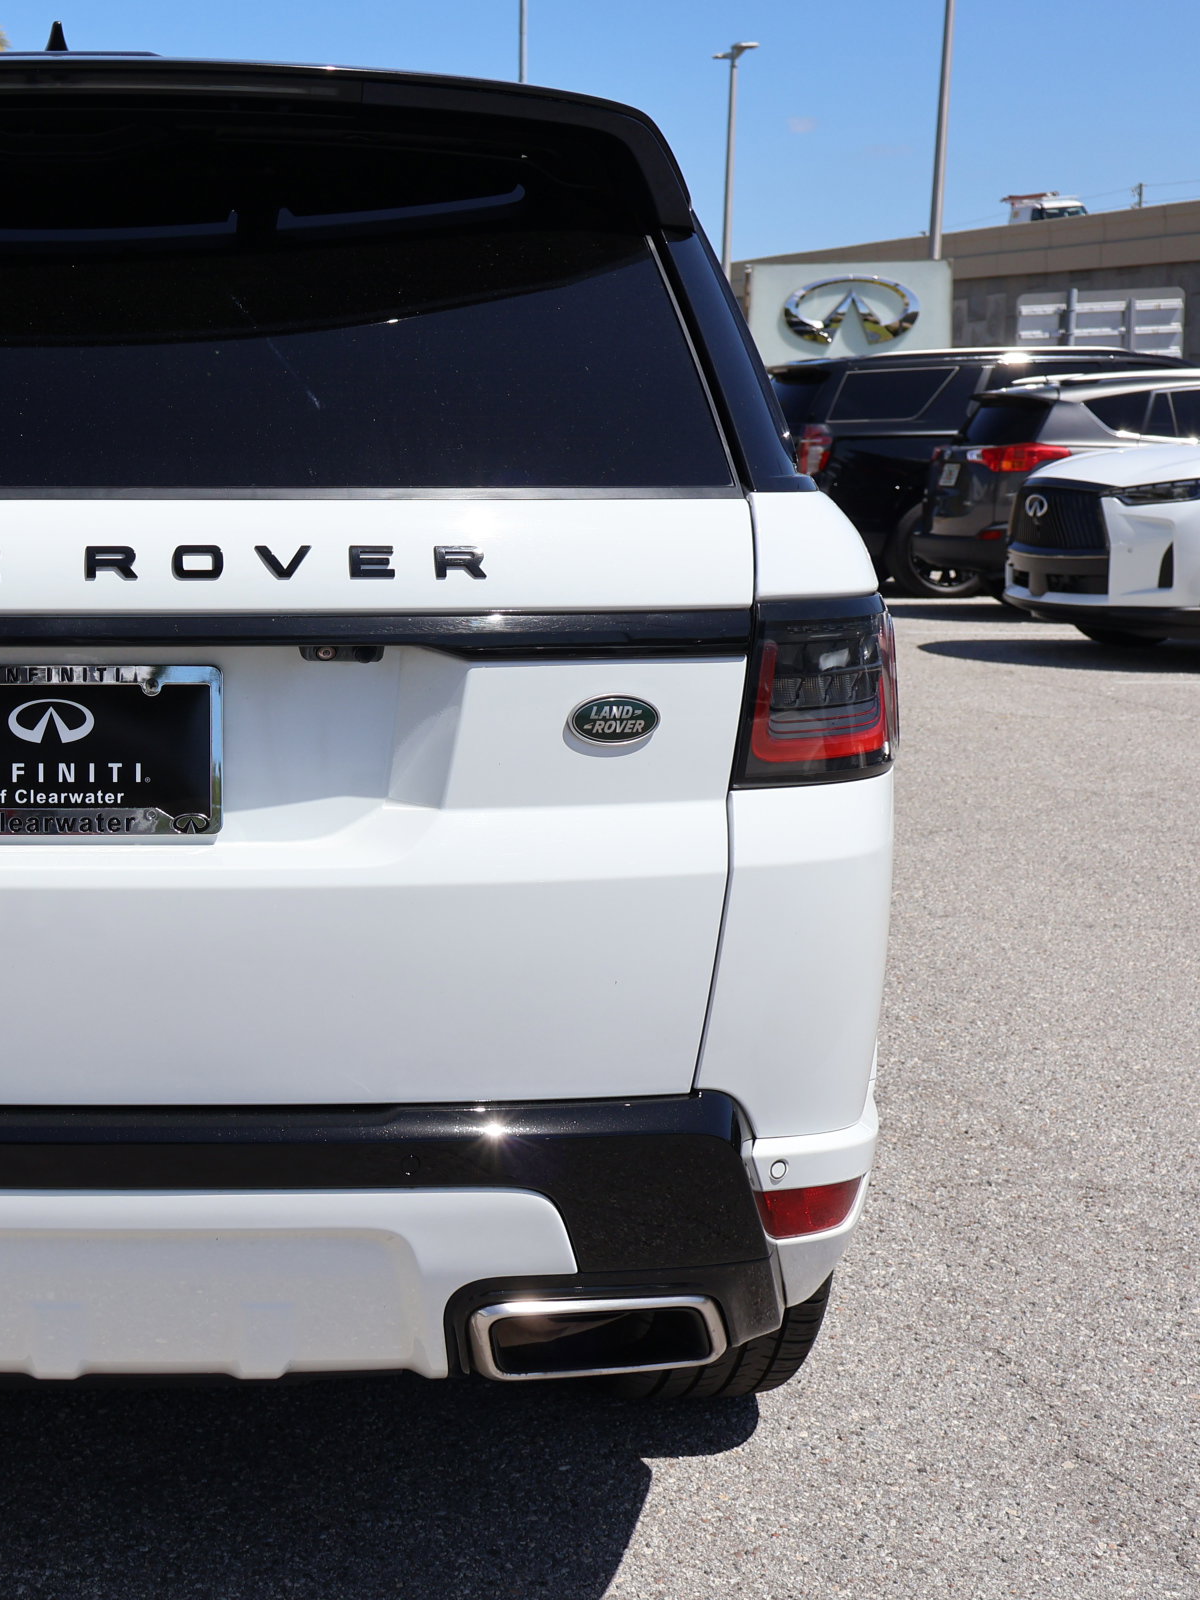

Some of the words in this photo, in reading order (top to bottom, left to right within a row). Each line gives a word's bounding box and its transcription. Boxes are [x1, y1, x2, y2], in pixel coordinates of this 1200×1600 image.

[84, 545, 488, 581] ROVER
[590, 705, 633, 720] LAND
[592, 720, 644, 733] ROVER
[15, 789, 125, 804] Clearwater
